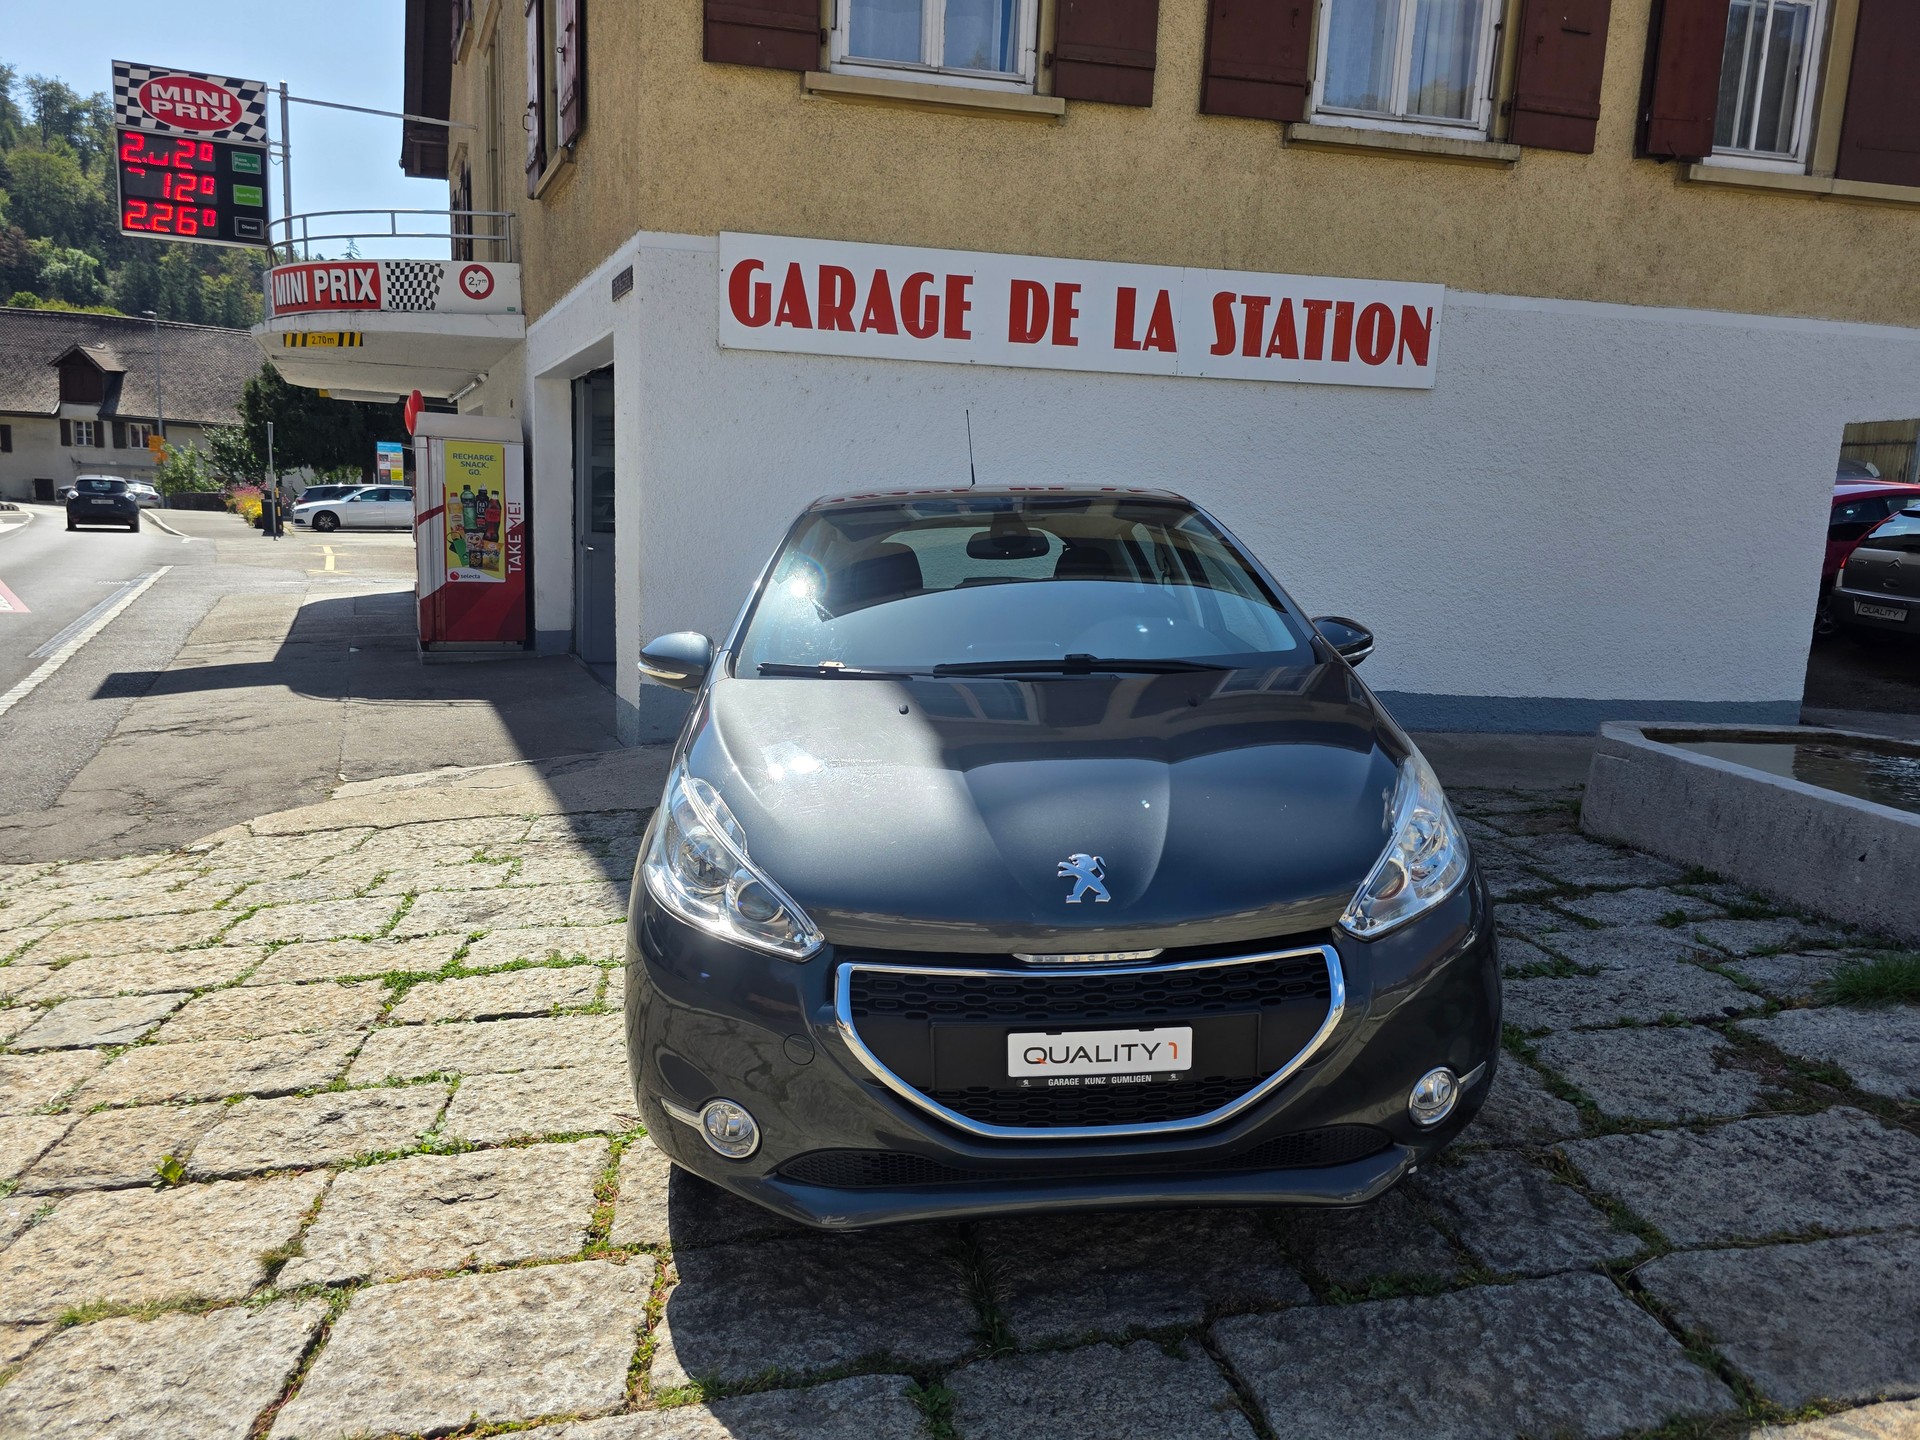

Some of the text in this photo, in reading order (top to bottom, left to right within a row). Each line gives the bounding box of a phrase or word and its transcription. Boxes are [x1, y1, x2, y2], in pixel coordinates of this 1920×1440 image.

[150, 83, 231, 108] MINI
[151, 99, 233, 124] PRIX
[275, 268, 377, 308] MINI PRIX
[728, 258, 1433, 368] GARAGE DE LA STATION
[452, 452, 497, 462] RECHARGE.
[460, 460, 489, 469] SNACK.
[468, 468, 482, 476] GO.
[507, 501, 522, 574] TAKE ME!
[1861, 606, 1900, 618] QUALITY
[1023, 1042, 1178, 1065] QUALITY 1
[1048, 1078, 1080, 1086] GARAGE
[1084, 1076, 1107, 1085] KUNZ
